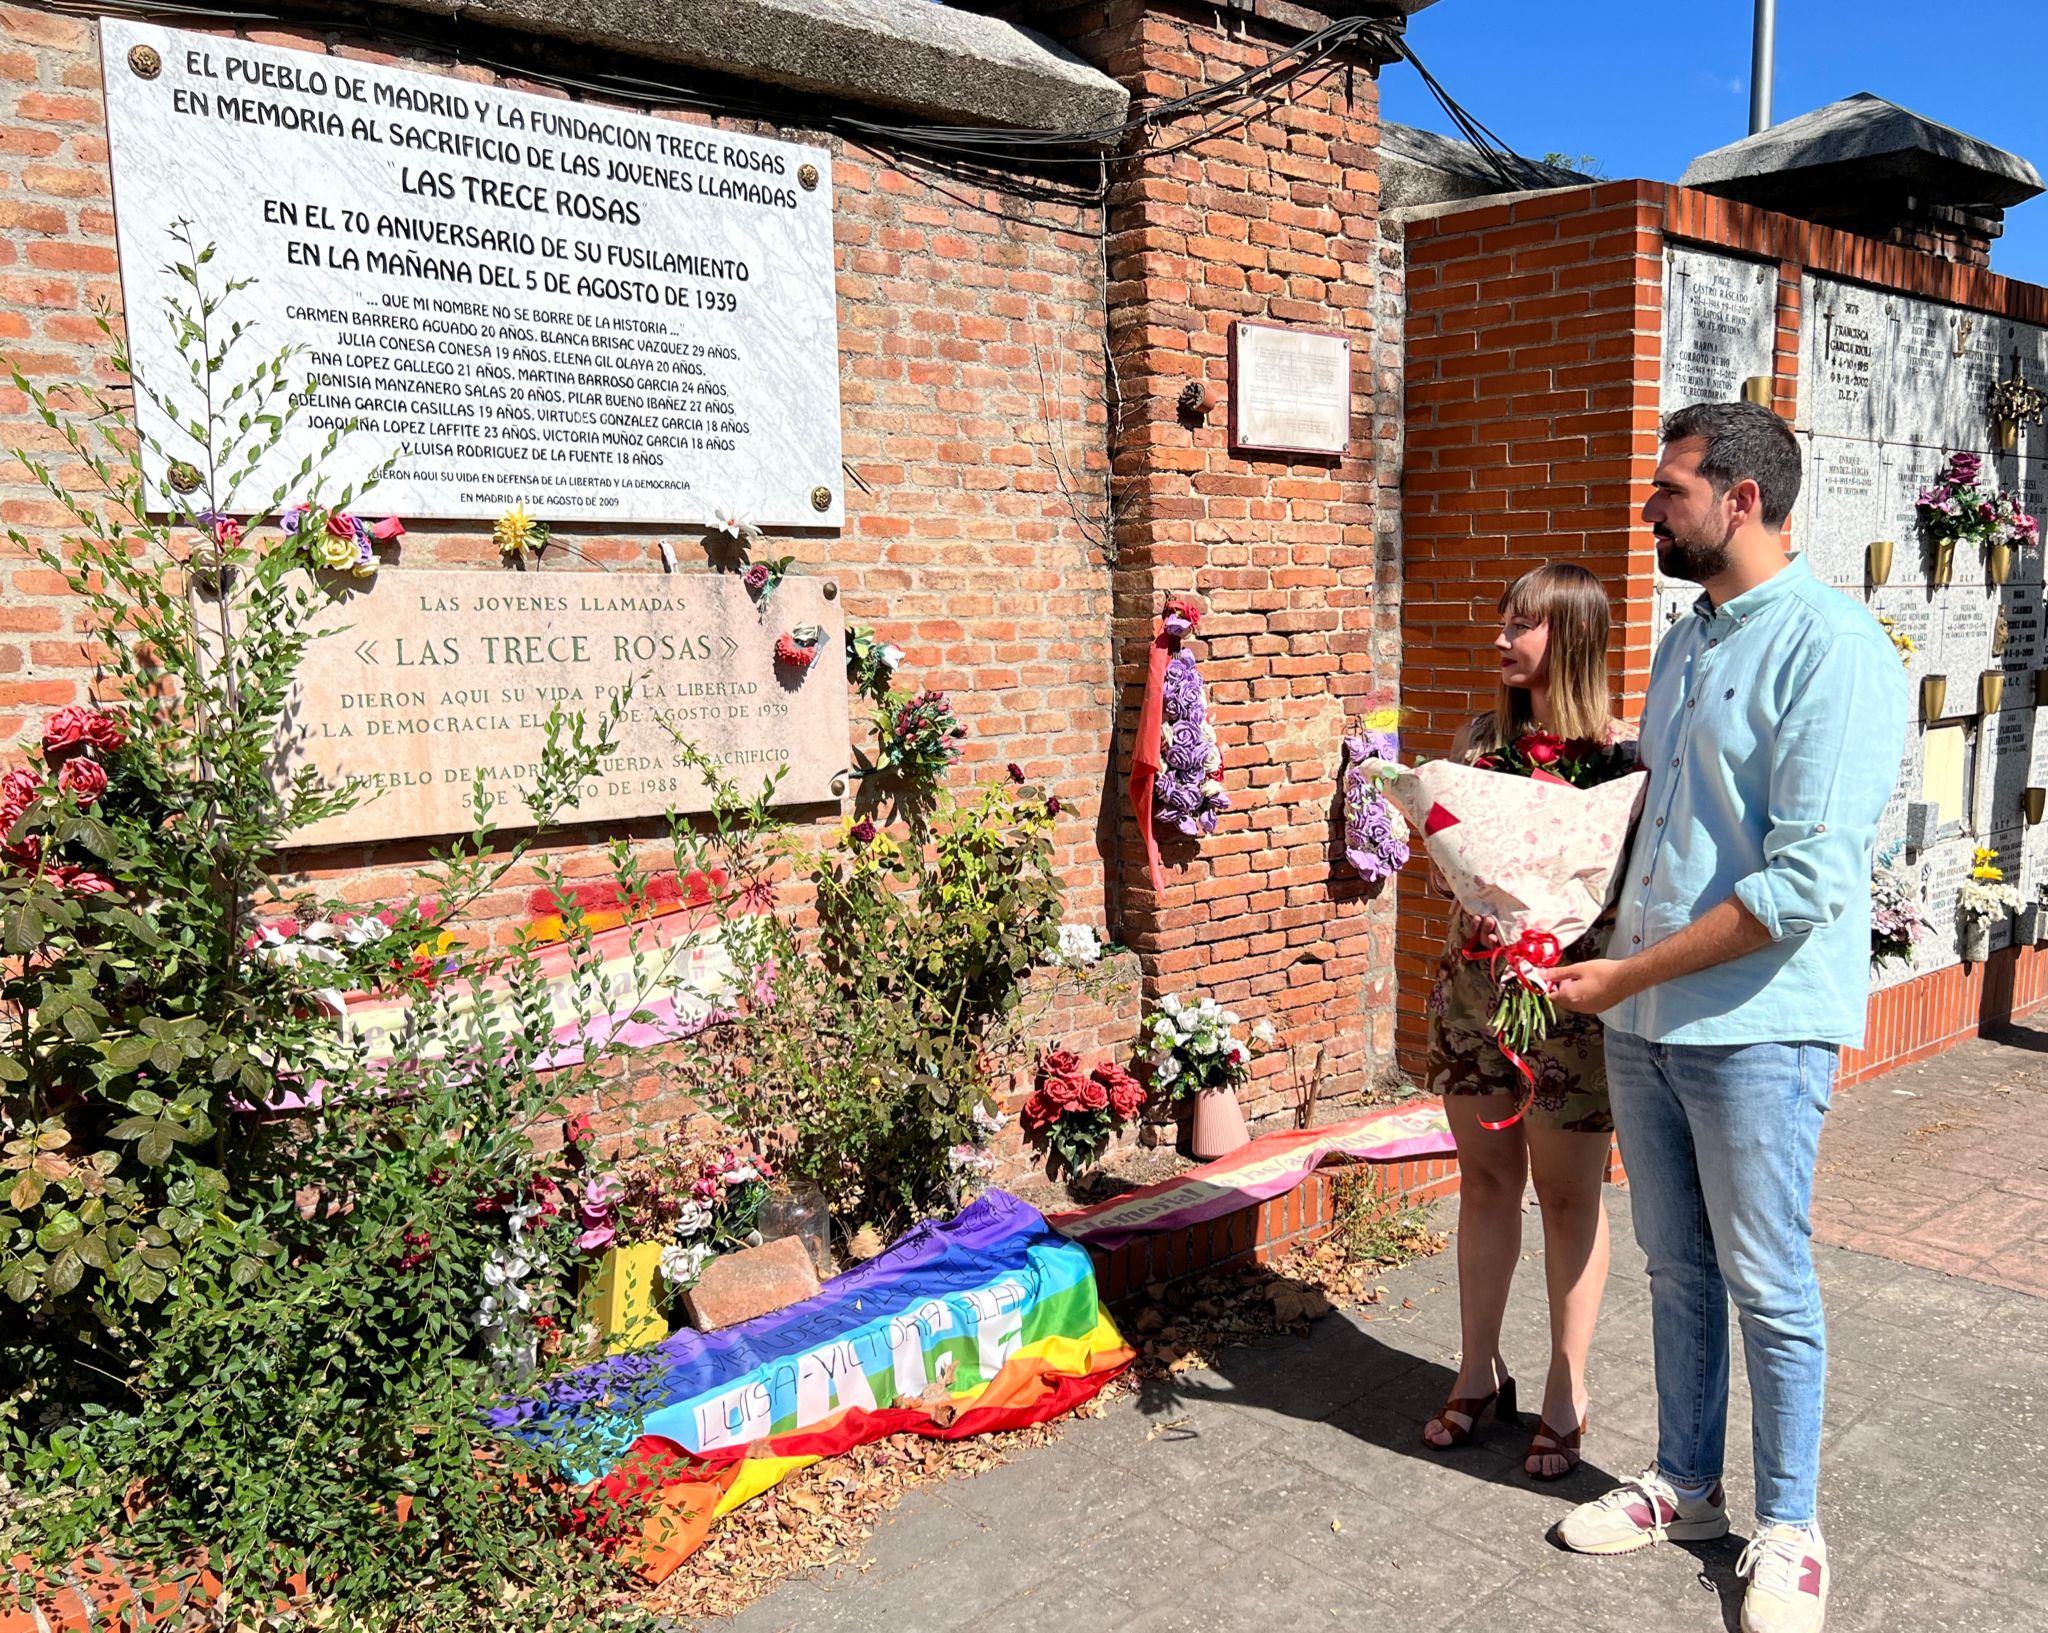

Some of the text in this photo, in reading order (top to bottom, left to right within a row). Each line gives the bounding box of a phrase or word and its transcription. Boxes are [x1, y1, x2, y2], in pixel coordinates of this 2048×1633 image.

[186, 50, 785, 175] EL PUEBLO DE MADRID Y LA FUNDACION TRECE ROSAS
[173, 88, 797, 209] EN MEMORIA AL SACRIFICIO DE LAS JOVENES LLAMADAS
[462, 175, 548, 213] TRECE
[263, 199, 749, 281] EN EL 70 ANIVERSARIO DE SU FUSILAMIENTO
[287, 240, 737, 312] EN LA MAÑANA DEL 5 DE AGOSTO DE 1939
[286, 305, 689, 355] CARMEN BARRERO AGUADO BLANCA BRISAC VAZQUEZ
[381, 293, 667, 334] QUE MI NOMBRE NO SE BORRE DE LA HISTORIA
[1693, 340, 1718, 353] MARINA
[1834, 324, 1869, 341] FRANCISCA
[337, 331, 654, 371] JULIA CONESA CONESA ELENA GIL OLAYA
[309, 350, 679, 392] ANA LOPEZ GALLEGO MARTINA BARROSO GARCIA
[306, 372, 687, 411] DIONISIA MANZANERO SALAS PILAR BUENO IBAÑEZ
[288, 392, 703, 430] ADELINA GARCIA CASILLAS VIRTUDES GONZALEZ GARCIA
[383, 419, 425, 434] LOPEZ
[429, 422, 480, 438] LAFFITE
[542, 429, 599, 443] VICTORIA
[602, 430, 643, 446] MUÑOZ
[645, 434, 688, 448] GARCIA
[705, 436, 735, 451] AÑOS
[414, 442, 664, 466] LUISA RODRIGUEZ DE LA FUENTE AÑOS
[413, 470, 438, 481] AQUI
[440, 471, 454, 482] SU
[455, 472, 479, 482] VIDA
[481, 473, 494, 483] EN
[496, 473, 539, 485] DEFENSA
[540, 475, 553, 485] DE
[554, 476, 567, 486] LA
[568, 476, 612, 487] LIBERTAD
[621, 478, 633, 488] LA
[634, 479, 690, 490] DEMOCRACIA
[460, 492, 619, 507] EN MADRID 5 DE AGOSTO DE 2009
[419, 595, 686, 612] LAS JOVENES LLAMADAS
[480, 635, 590, 664] TRECE
[339, 692, 426, 709] DIERON
[439, 689, 489, 706] AQUI
[501, 688, 525, 702] SU
[536, 687, 582, 701] VIDA
[642, 684, 666, 698] LA
[677, 681, 757, 697] LIBERTAD
[322, 703, 788, 737] LA DEMOCRACIA EL 5 DE AGOSTO DE 1939
[443, 768, 470, 782] DE
[482, 763, 558, 780] MADRI
[460, 793, 472, 808] 5
[483, 790, 507, 805] DE
[608, 781, 631, 796] DE
[640, 777, 677, 793] 1988
